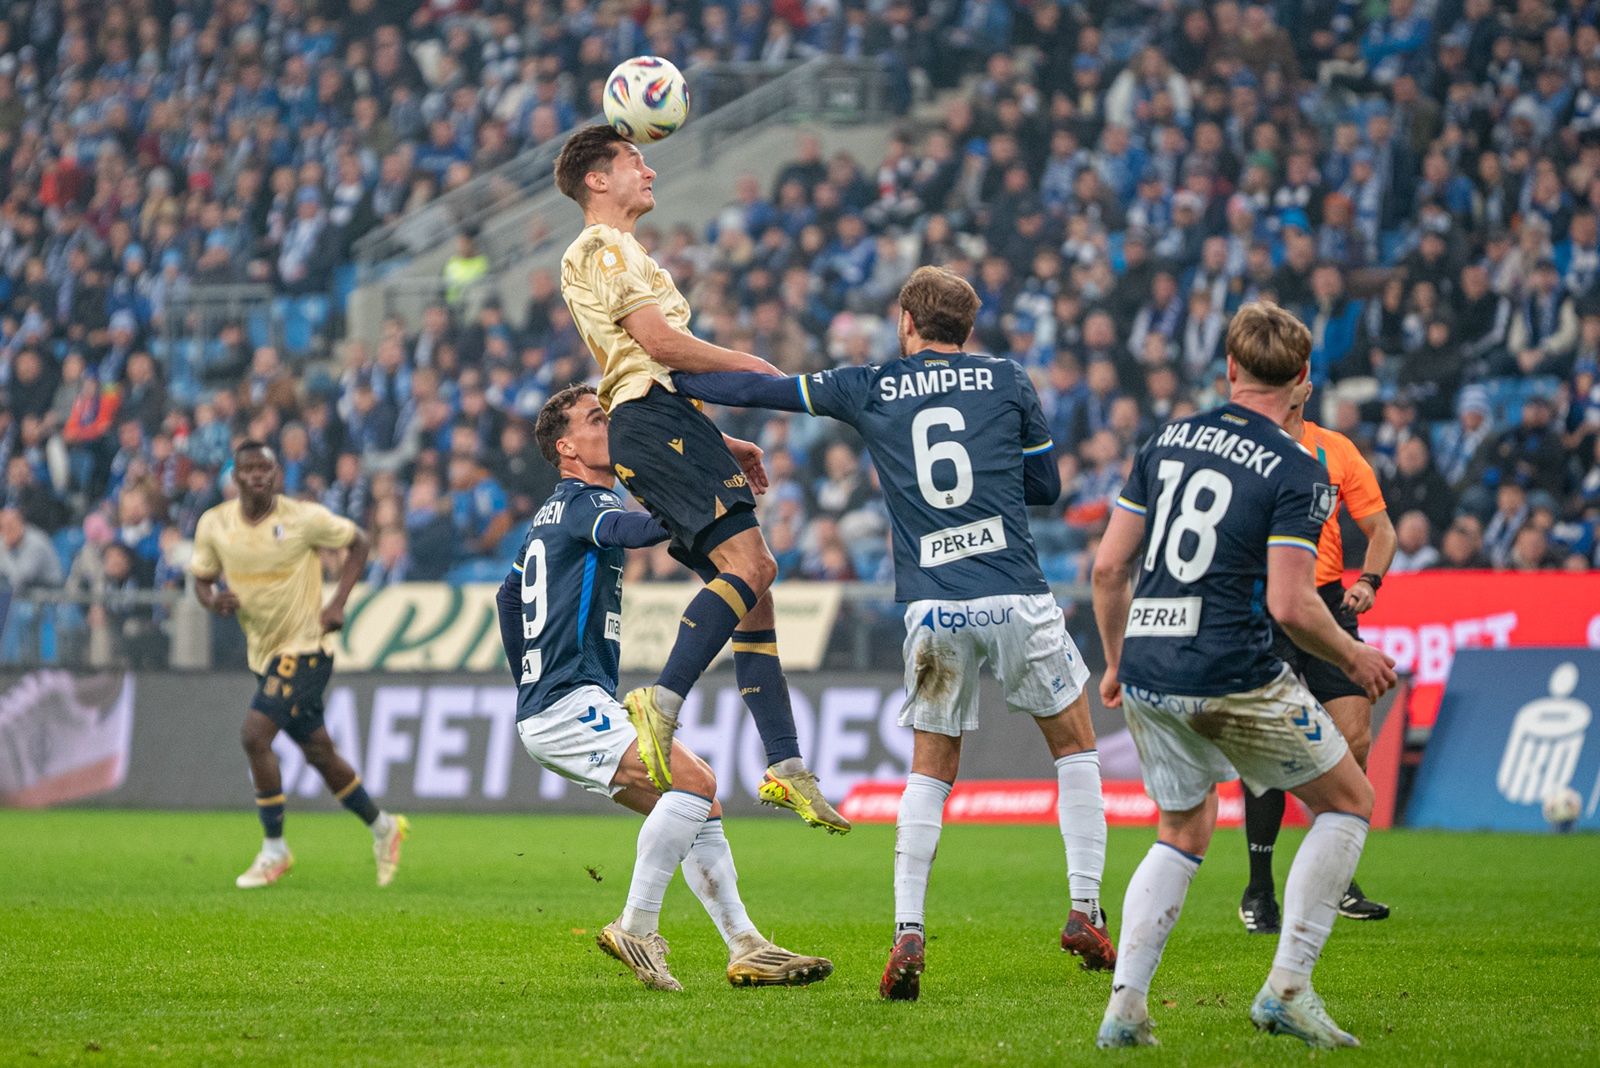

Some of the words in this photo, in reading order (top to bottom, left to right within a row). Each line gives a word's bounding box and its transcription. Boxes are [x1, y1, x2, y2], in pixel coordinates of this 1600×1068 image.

[879, 367, 994, 402] SAMPER
[911, 406, 974, 509] 6
[1156, 422, 1283, 479] NAJEMSKI
[931, 527, 994, 558] PERŁA
[1143, 459, 1233, 584] 18
[938, 605, 1014, 633] bptour
[1130, 606, 1187, 627] PERŁA
[250, 686, 564, 798] AFET
